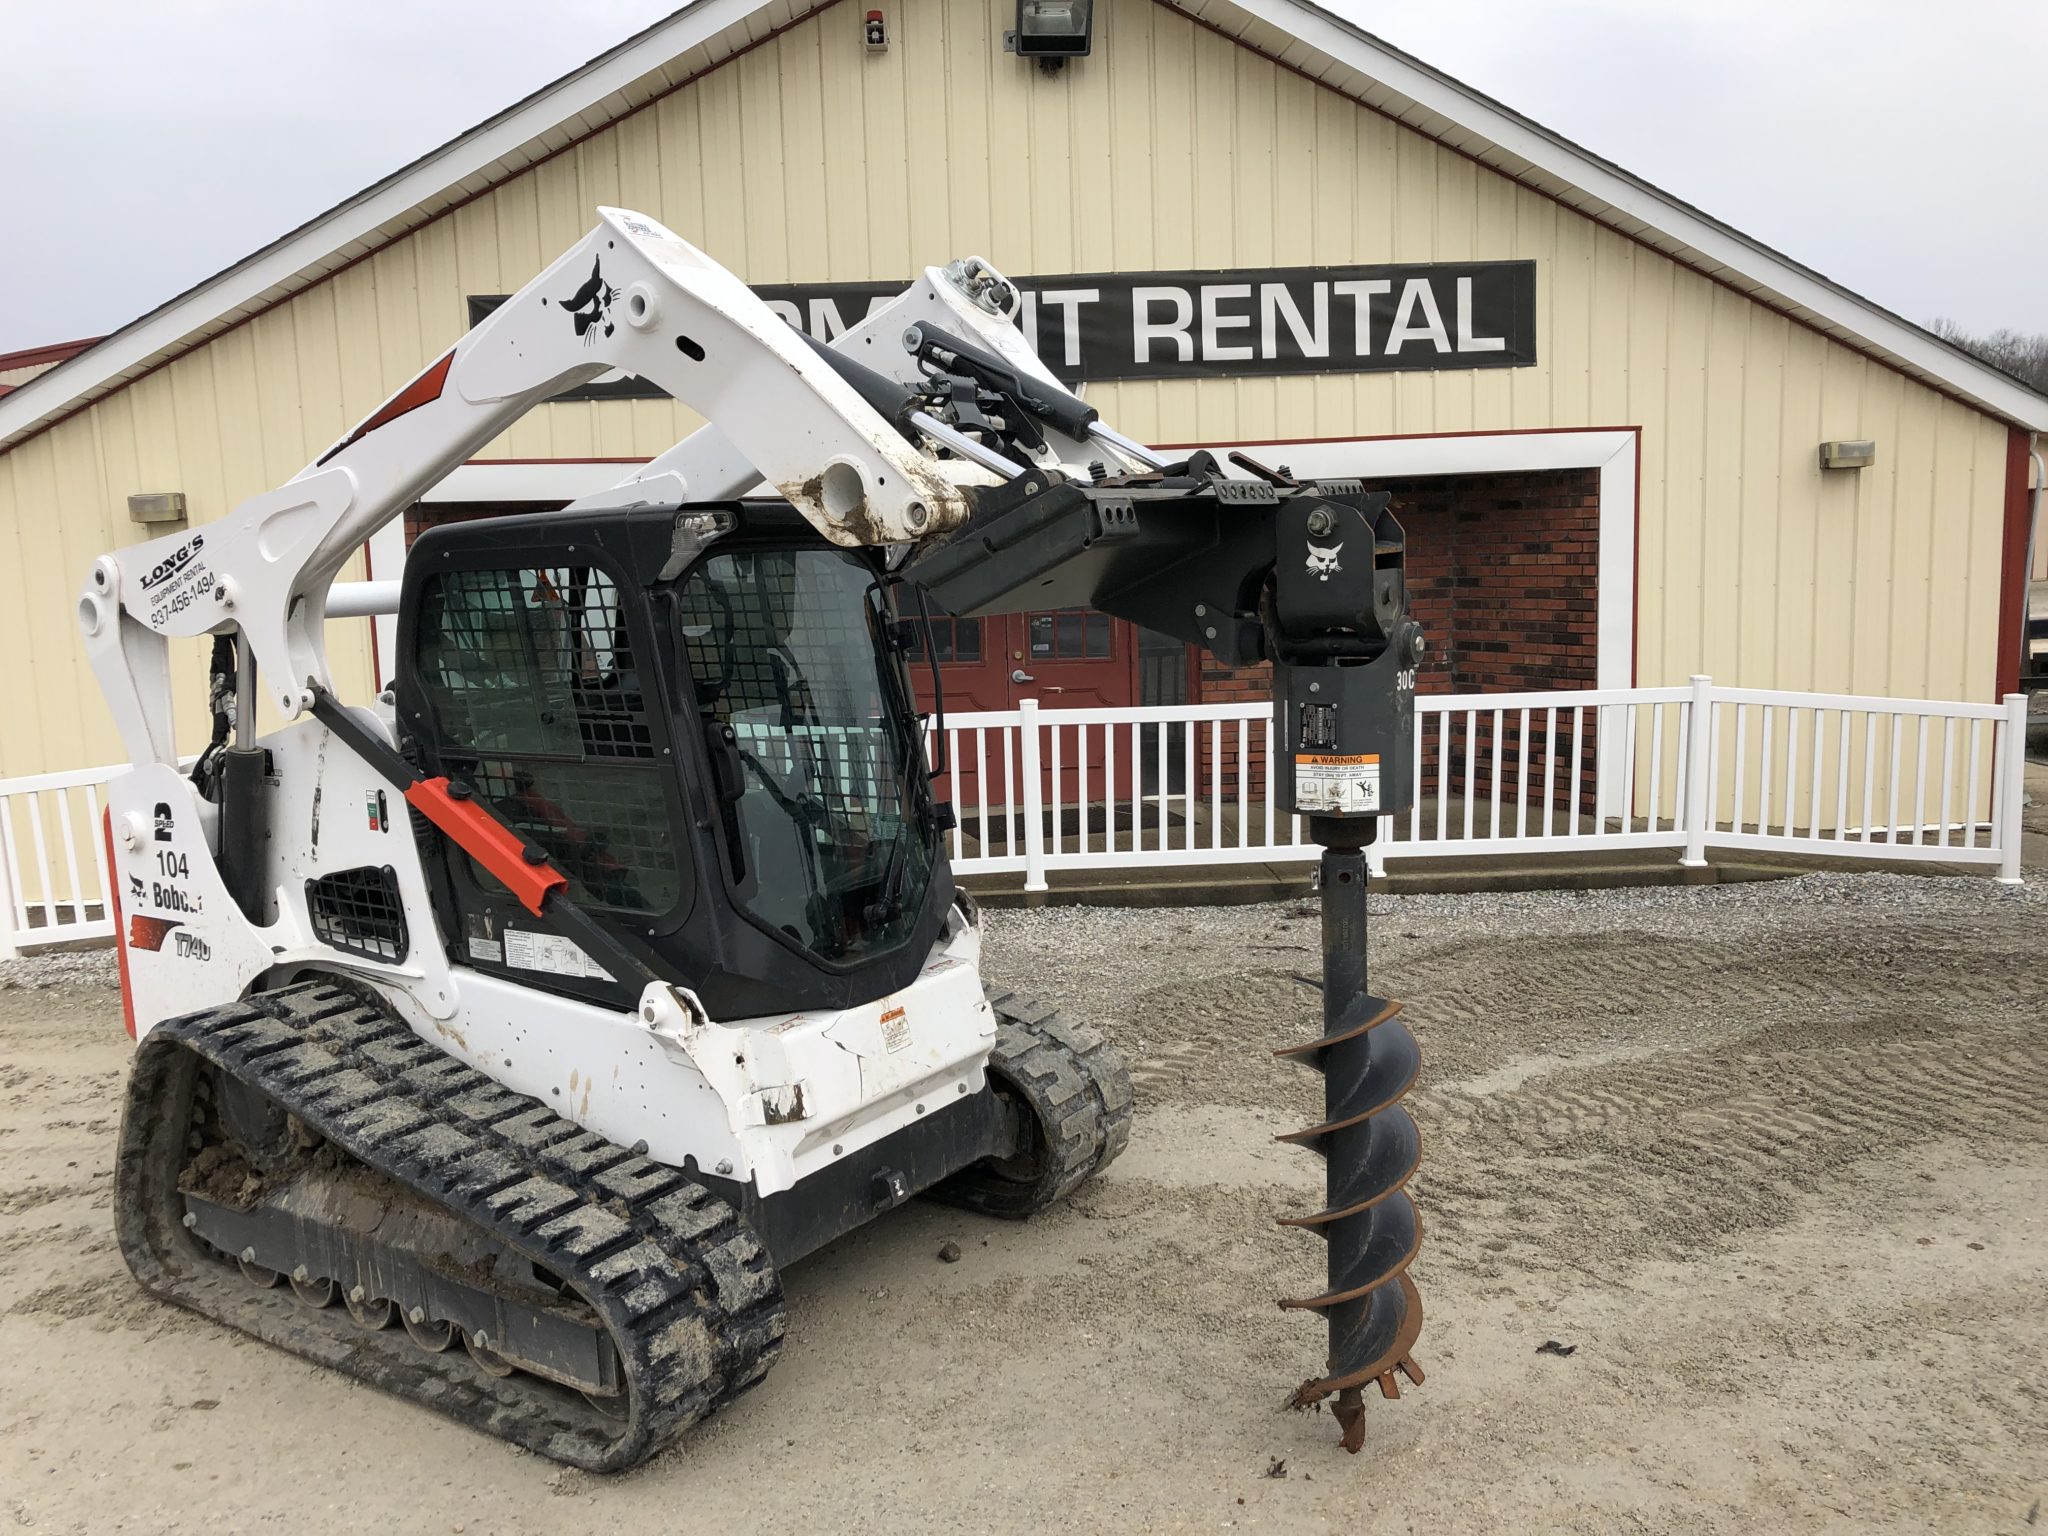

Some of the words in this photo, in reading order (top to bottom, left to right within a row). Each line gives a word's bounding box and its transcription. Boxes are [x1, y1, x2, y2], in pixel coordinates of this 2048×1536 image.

[1132, 276, 1506, 363] RENTAL
[139, 533, 205, 590] LONG'S
[150, 576, 183, 607] EQUIPMENT
[183, 561, 207, 583] RENTAL
[151, 571, 216, 629] 937-456-1494
[1396, 668, 1415, 692] 30C
[1320, 756, 1363, 765] WARNING
[154, 802, 172, 842] 2
[154, 819, 175, 829] SPEED
[156, 849, 189, 880] 104
[153, 881, 204, 915] Bobc
